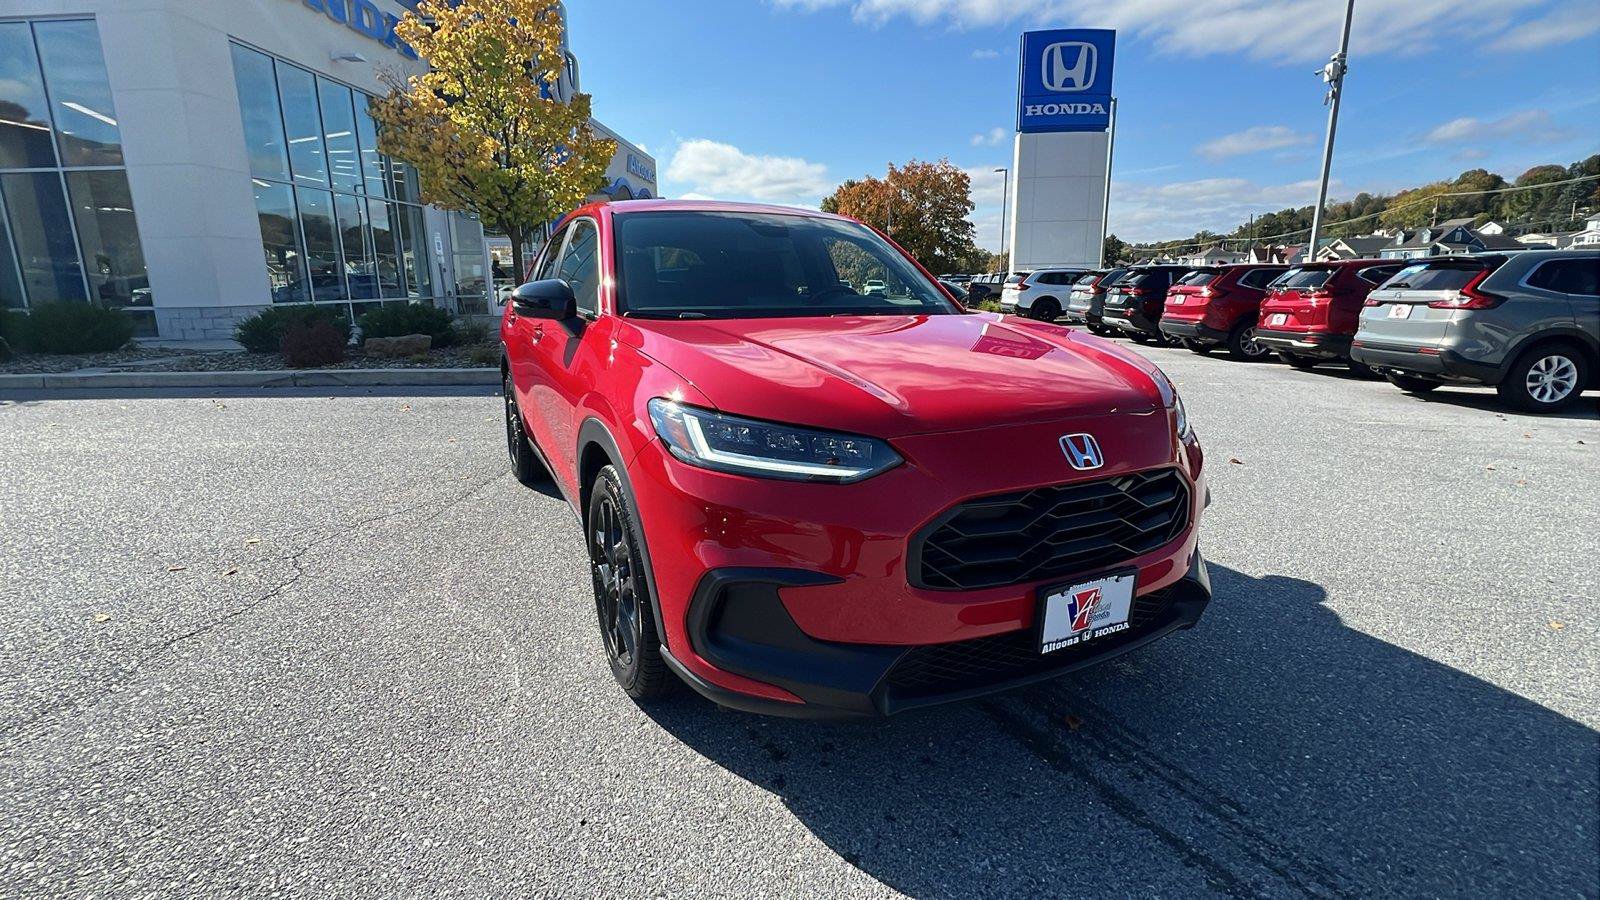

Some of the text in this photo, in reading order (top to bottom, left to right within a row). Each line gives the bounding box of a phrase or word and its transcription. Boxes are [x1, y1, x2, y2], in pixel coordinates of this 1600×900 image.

[1025, 103, 1107, 116] HONDA
[1041, 636, 1080, 654] Altoona
[1094, 622, 1130, 638] HONDA
